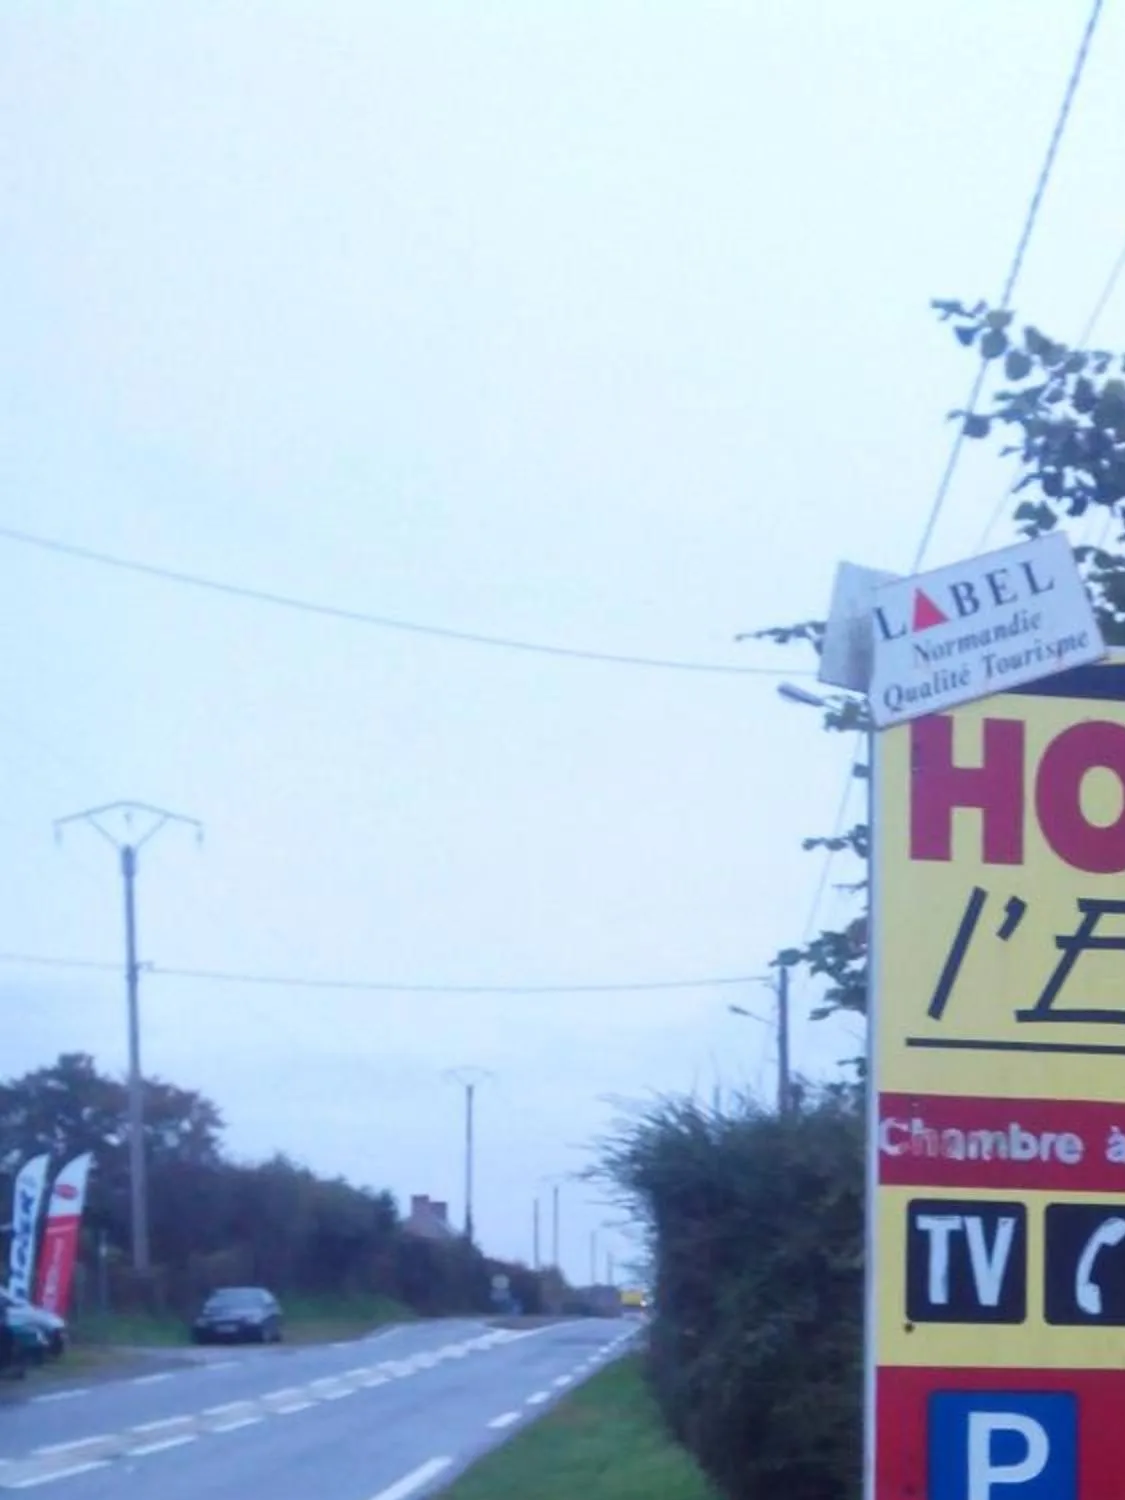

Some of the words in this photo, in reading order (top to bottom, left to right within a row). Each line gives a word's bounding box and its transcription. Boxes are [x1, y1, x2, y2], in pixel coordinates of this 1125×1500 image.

[884, 661, 972, 712] Qualité
[981, 629, 1089, 679] Tourisme
[912, 611, 1042, 663] Normandie
[879, 1116, 1084, 1165] Chambre
[916, 1215, 1016, 1307] TV
